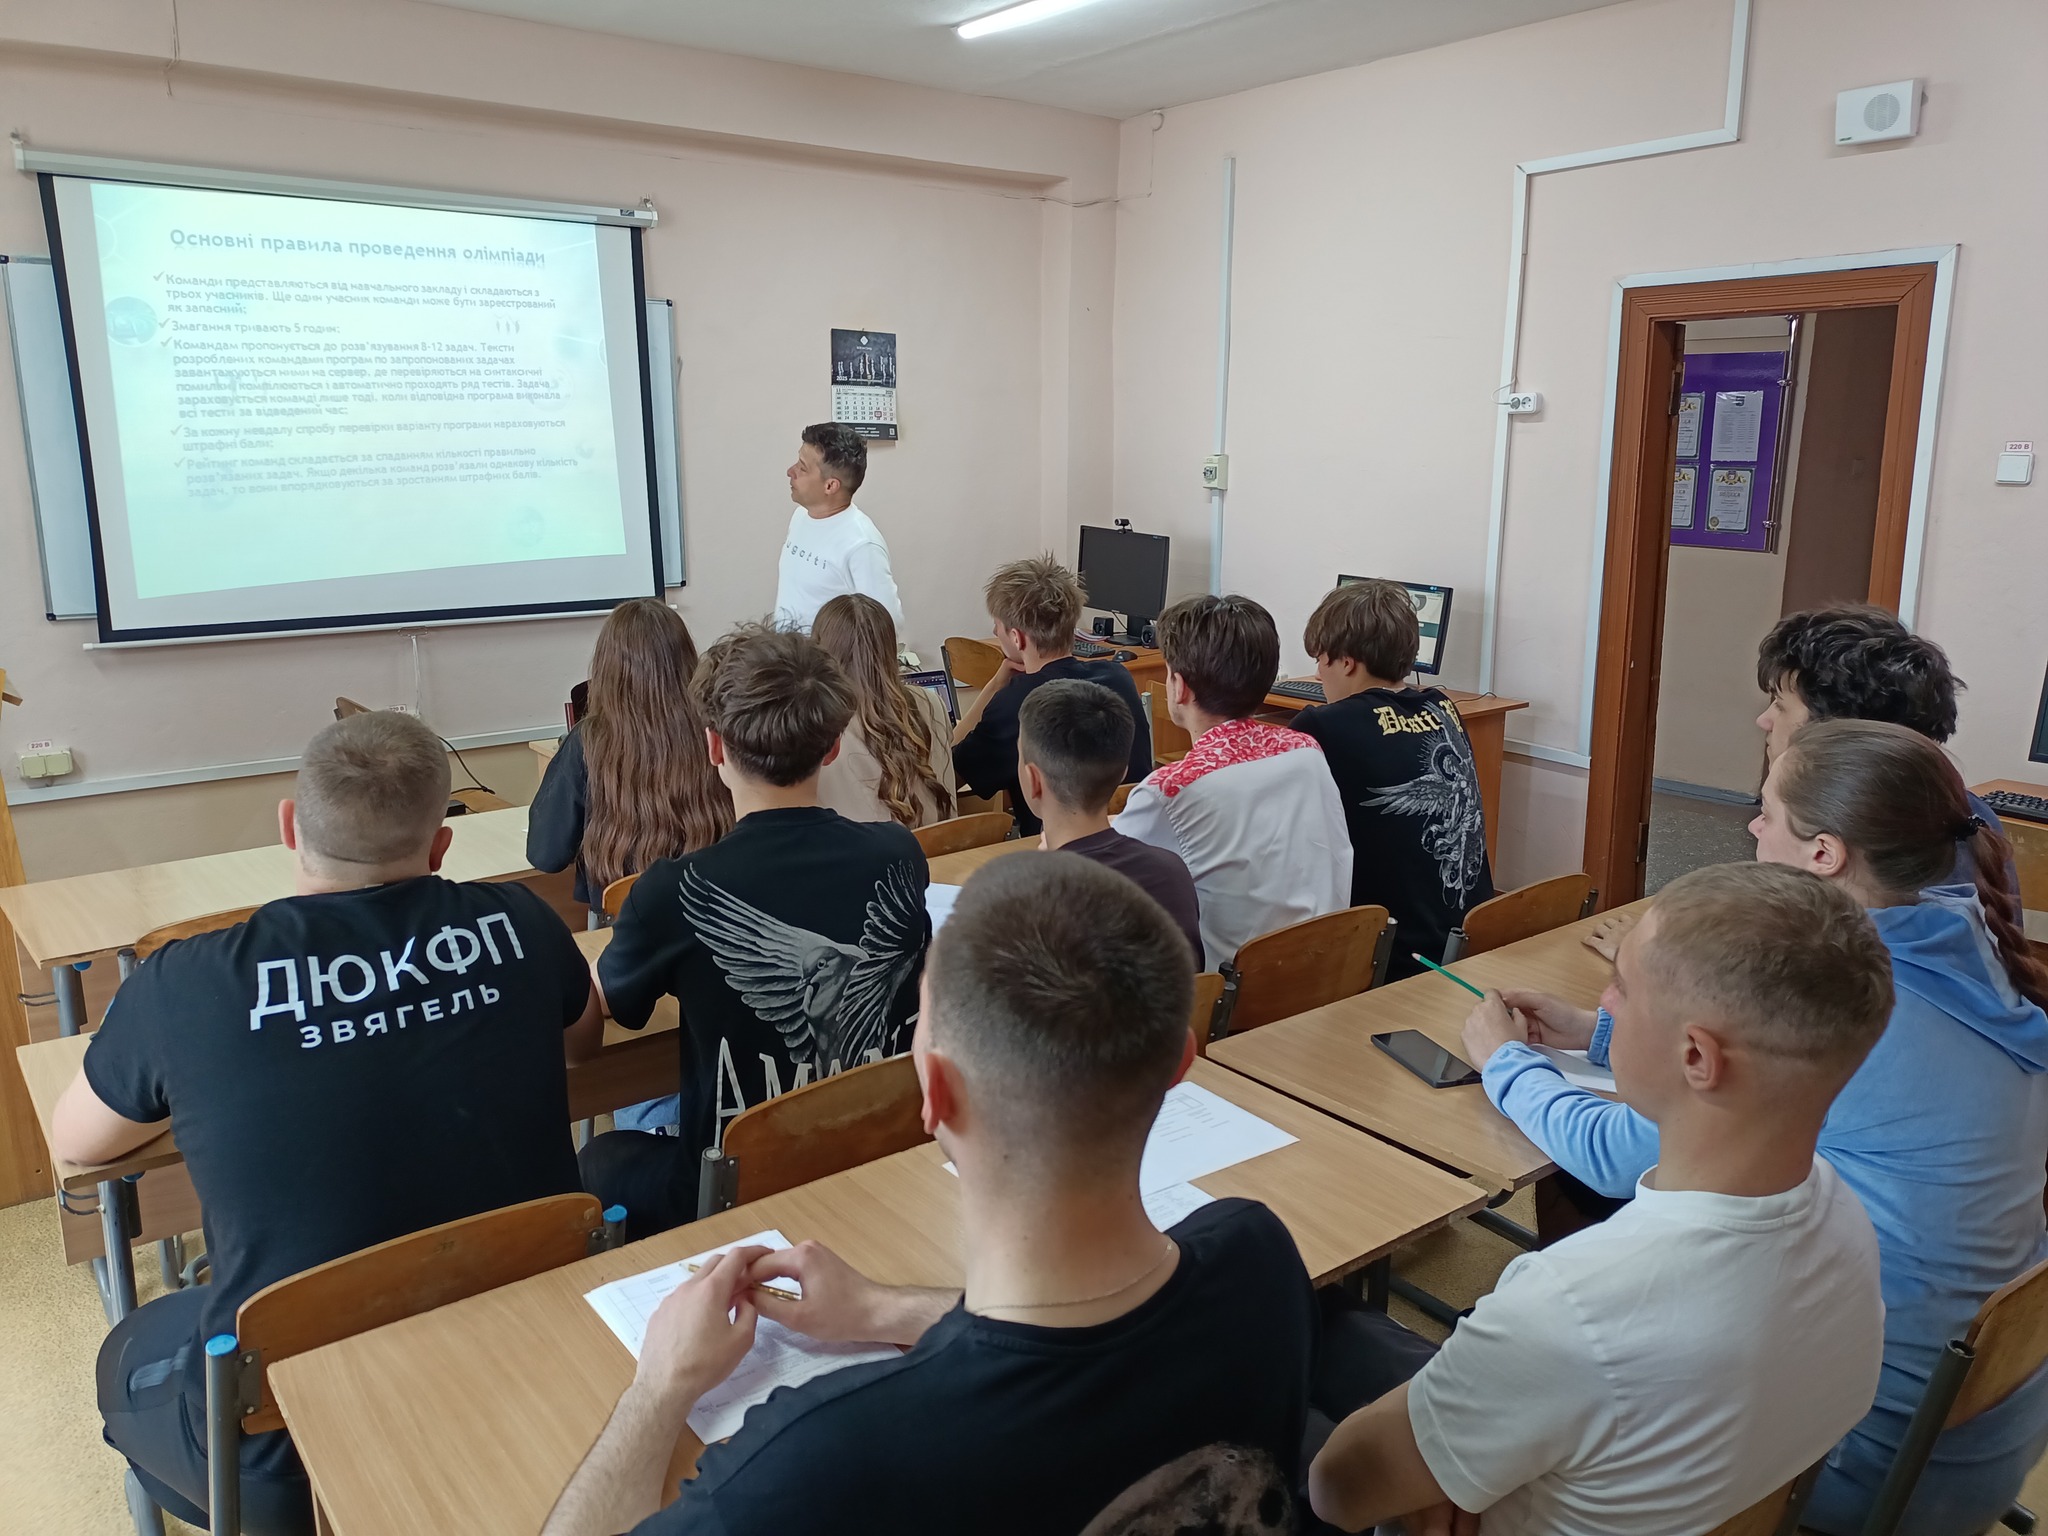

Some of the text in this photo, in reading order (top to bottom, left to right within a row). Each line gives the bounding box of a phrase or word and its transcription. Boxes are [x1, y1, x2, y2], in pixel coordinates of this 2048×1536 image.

[170, 229, 545, 266] Основні правила проведення олімпіади
[166, 274, 222, 287] Команди
[225, 278, 328, 290] представляються
[331, 280, 348, 291] від
[351, 282, 419, 292] навчального
[421, 285, 462, 296] закладу
[464, 284, 467, 294] і
[470, 287, 533, 297] складаються
[166, 289, 202, 300] трьох
[272, 291, 292, 303] Ще
[294, 294, 322, 303] один
[326, 294, 370, 304] учасник
[373, 296, 420, 306] команди
[422, 297, 450, 306] може
[453, 297, 477, 308] бути
[479, 298, 556, 310] зареєстрований
[167, 303, 183, 312] як
[172, 320, 232, 332] Змагання
[234, 323, 291, 334] тривають
[294, 322, 301, 333] 5
[173, 339, 239, 351] Командам
[241, 342, 320, 353] пропонується
[323, 343, 337, 352] до
[421, 342, 443, 352] 8-12
[480, 342, 514, 352] Тексти
[173, 354, 515, 367] розроблених командами програм по запропонованих задачах
[175, 369, 277, 380] завантажуються
[312, 369, 326, 377] на
[374, 369, 387, 378] де
[391, 367, 467, 378] перевіряються
[469, 369, 481, 377] на
[405, 381, 458, 391] проходять
[410, 392, 464, 403] відповідна
[467, 391, 514, 402] програма
[183, 427, 199, 438] За
[443, 421, 492, 432] програми
[436, 448, 482, 459] кількості
[484, 447, 536, 458] правильно
[250, 912, 524, 1031] ДЮКФП
[299, 984, 500, 1048] ЗВЯГЕЛЬ
